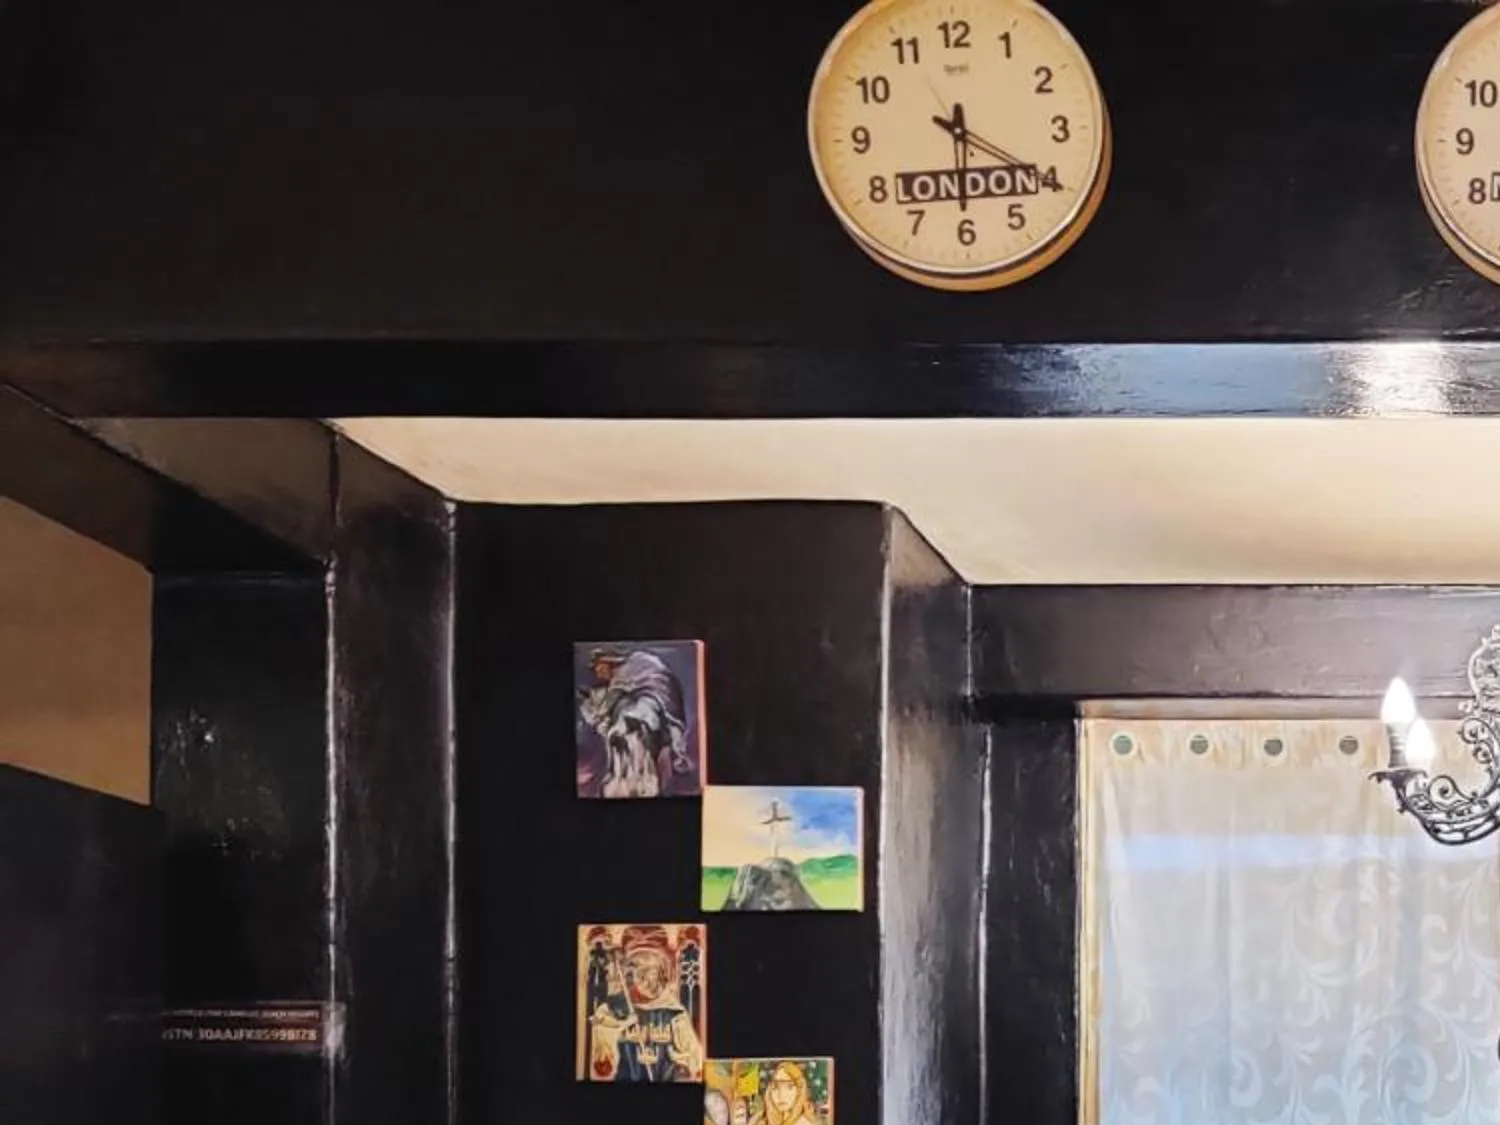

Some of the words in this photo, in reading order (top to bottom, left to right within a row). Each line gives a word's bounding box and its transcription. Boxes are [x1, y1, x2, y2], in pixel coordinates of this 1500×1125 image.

[937, 21, 971, 48] 12
[998, 32, 1011, 58] 1
[891, 37, 920, 64] 11
[856, 76, 890, 104] 10
[1035, 66, 1053, 94] 2
[1465, 80, 1497, 107] 10
[852, 126, 870, 153] 9
[1052, 116, 1069, 143] 3
[1456, 128, 1474, 155] 9
[870, 176, 887, 203] 8
[898, 171, 1037, 201] LONDON
[1041, 166, 1057, 192] 4
[1469, 178, 1486, 204] 8
[907, 210, 925, 235] 7
[1008, 204, 1025, 229] 5
[958, 220, 976, 245] 6
